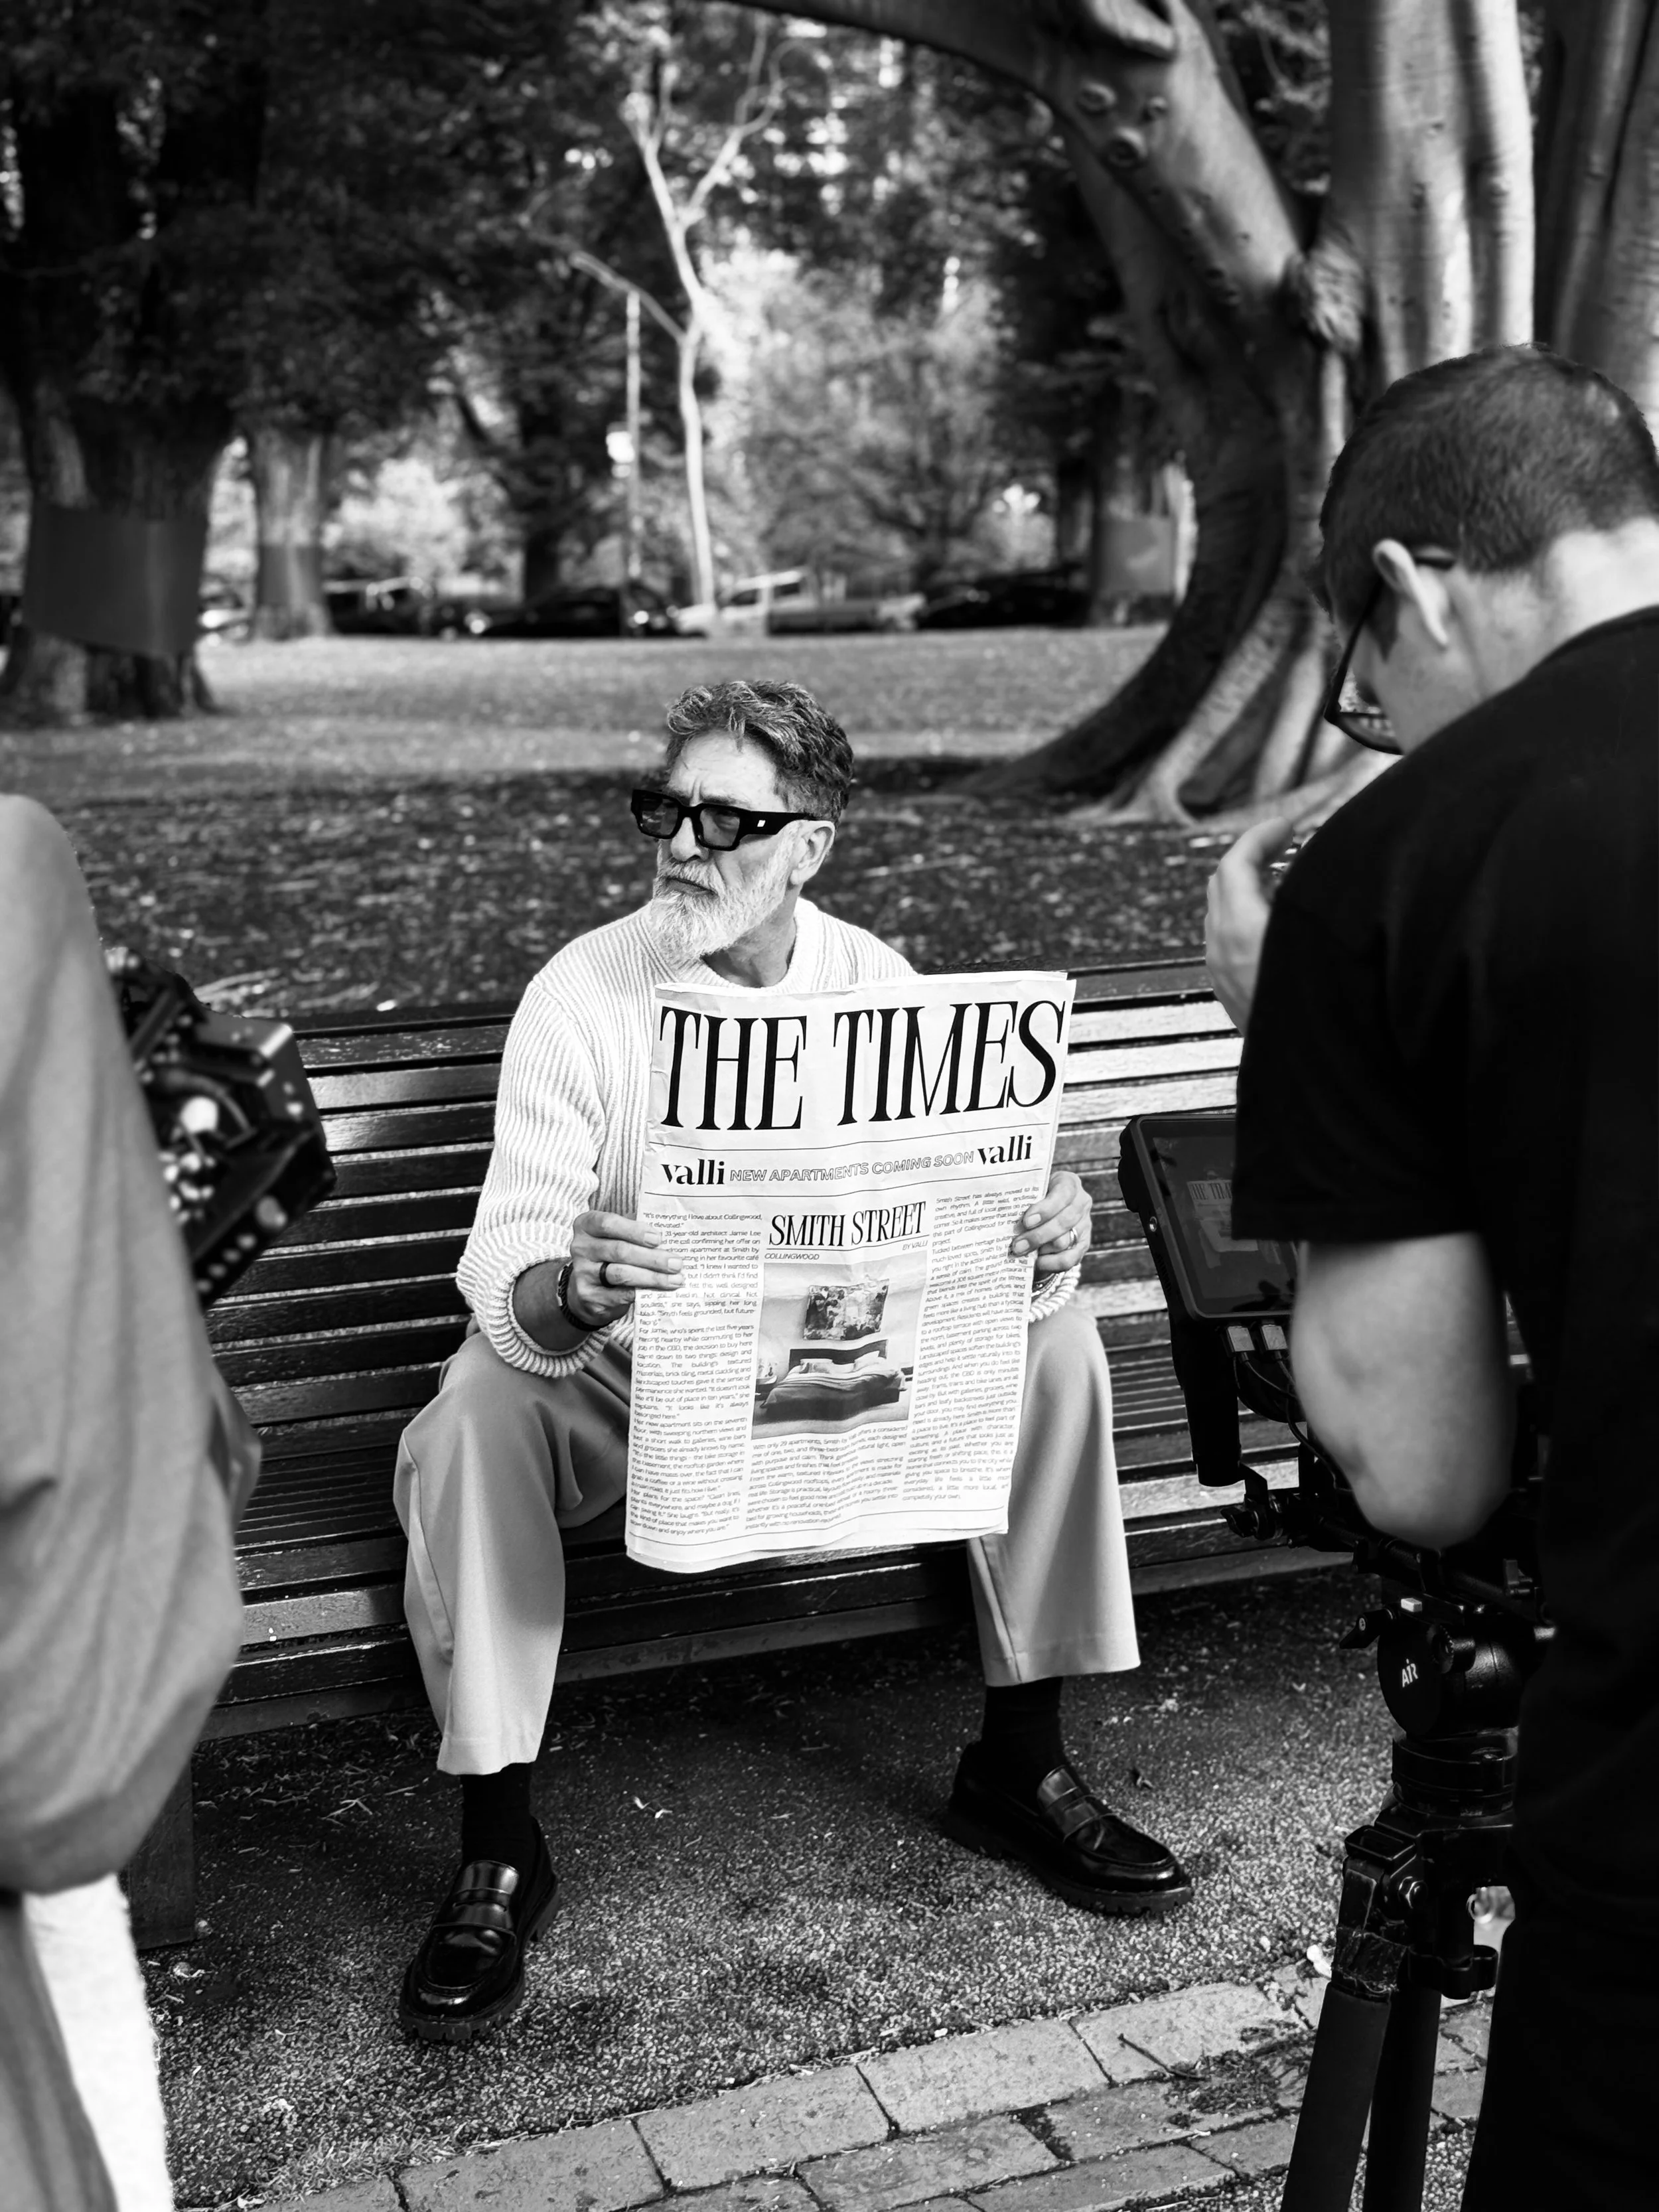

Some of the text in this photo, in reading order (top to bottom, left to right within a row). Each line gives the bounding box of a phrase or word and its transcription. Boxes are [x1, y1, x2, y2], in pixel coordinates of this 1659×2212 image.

[660, 1000, 1066, 1130] THE TIMES
[661, 1135, 1032, 1185] valli NEW APARTMENTS COMING SOON valli
[768, 1201, 926, 1246] SMITH STREET
[902, 1240, 928, 1251] BY VALLI
